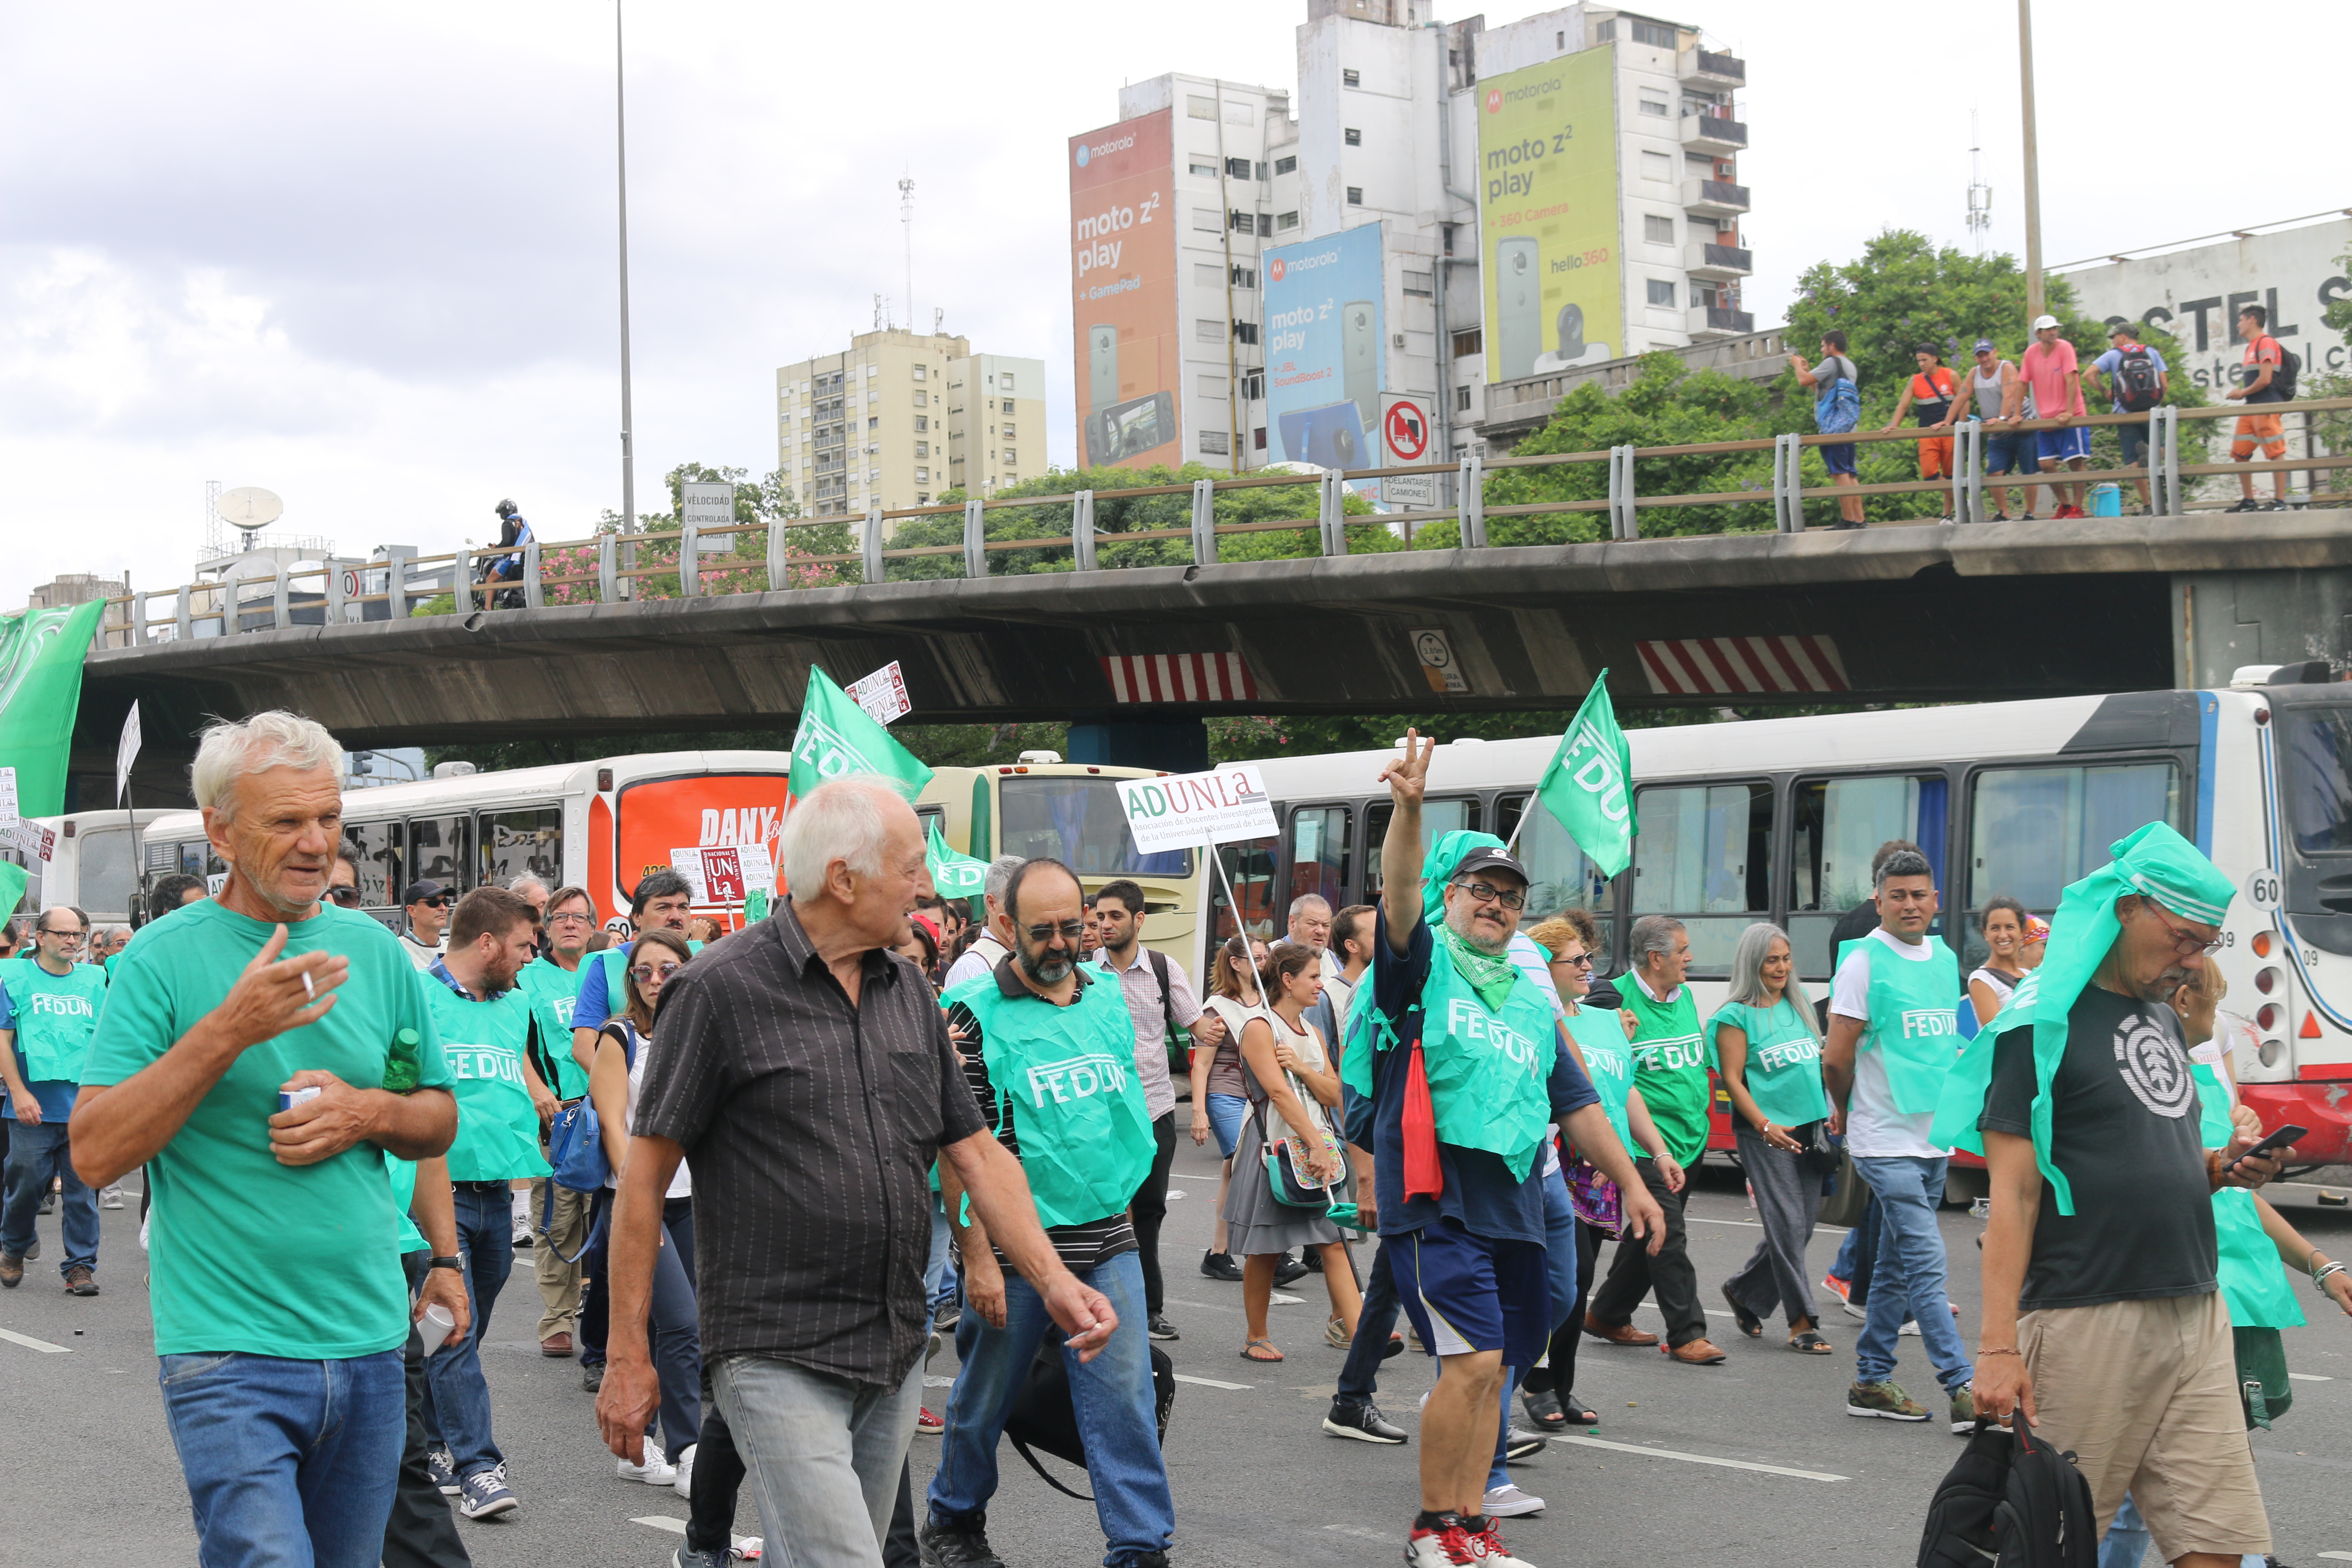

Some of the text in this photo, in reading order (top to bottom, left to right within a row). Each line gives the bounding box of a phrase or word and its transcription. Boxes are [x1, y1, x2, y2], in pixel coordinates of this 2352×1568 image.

[1505, 78, 1561, 104] motorola
[1090, 136, 1133, 159] motorola
[1488, 138, 1545, 171] moto
[1488, 171, 1534, 204] play
[1078, 206, 1133, 241] moto
[1500, 211, 1522, 228] 360
[1525, 203, 1569, 221] Camera
[1078, 240, 1122, 277] play
[1287, 251, 1338, 273] motorola
[1089, 275, 1141, 300] GamePad
[1272, 306, 1314, 330] moto
[1273, 330, 1305, 355] play
[1274, 367, 1332, 387] SoundBoost 2
[1281, 361, 1297, 373] JBL
[1384, 476, 1432, 487] ADELANTARSE
[1390, 487, 1427, 498] CAMIONES
[687, 496, 729, 505] VELOCIDAD
[791, 710, 864, 781] FED
[1128, 772, 1253, 820] ADUNLa
[699, 806, 777, 846] DANY
[1133, 806, 1272, 832] Asociación de Docentes Investigadores
[1141, 834, 1150, 842] de
[1151, 832, 1159, 841] la
[1159, 826, 1204, 840] Universidad
[1210, 823, 1242, 833] Nacional
[1254, 817, 1275, 827] Lanús
[703, 852, 712, 882] UNIVERSIDAD
[710, 858, 734, 877] UN
[2254, 879, 2278, 902] 60
[2303, 950, 2318, 966] 09
[31, 993, 94, 1019] FEDUN
[1448, 998, 1540, 1080] FEDUN
[1632, 1033, 1704, 1071] EDU
[1758, 1037, 1821, 1073] FEDUN
[1026, 1053, 1127, 1109] FEDUN
